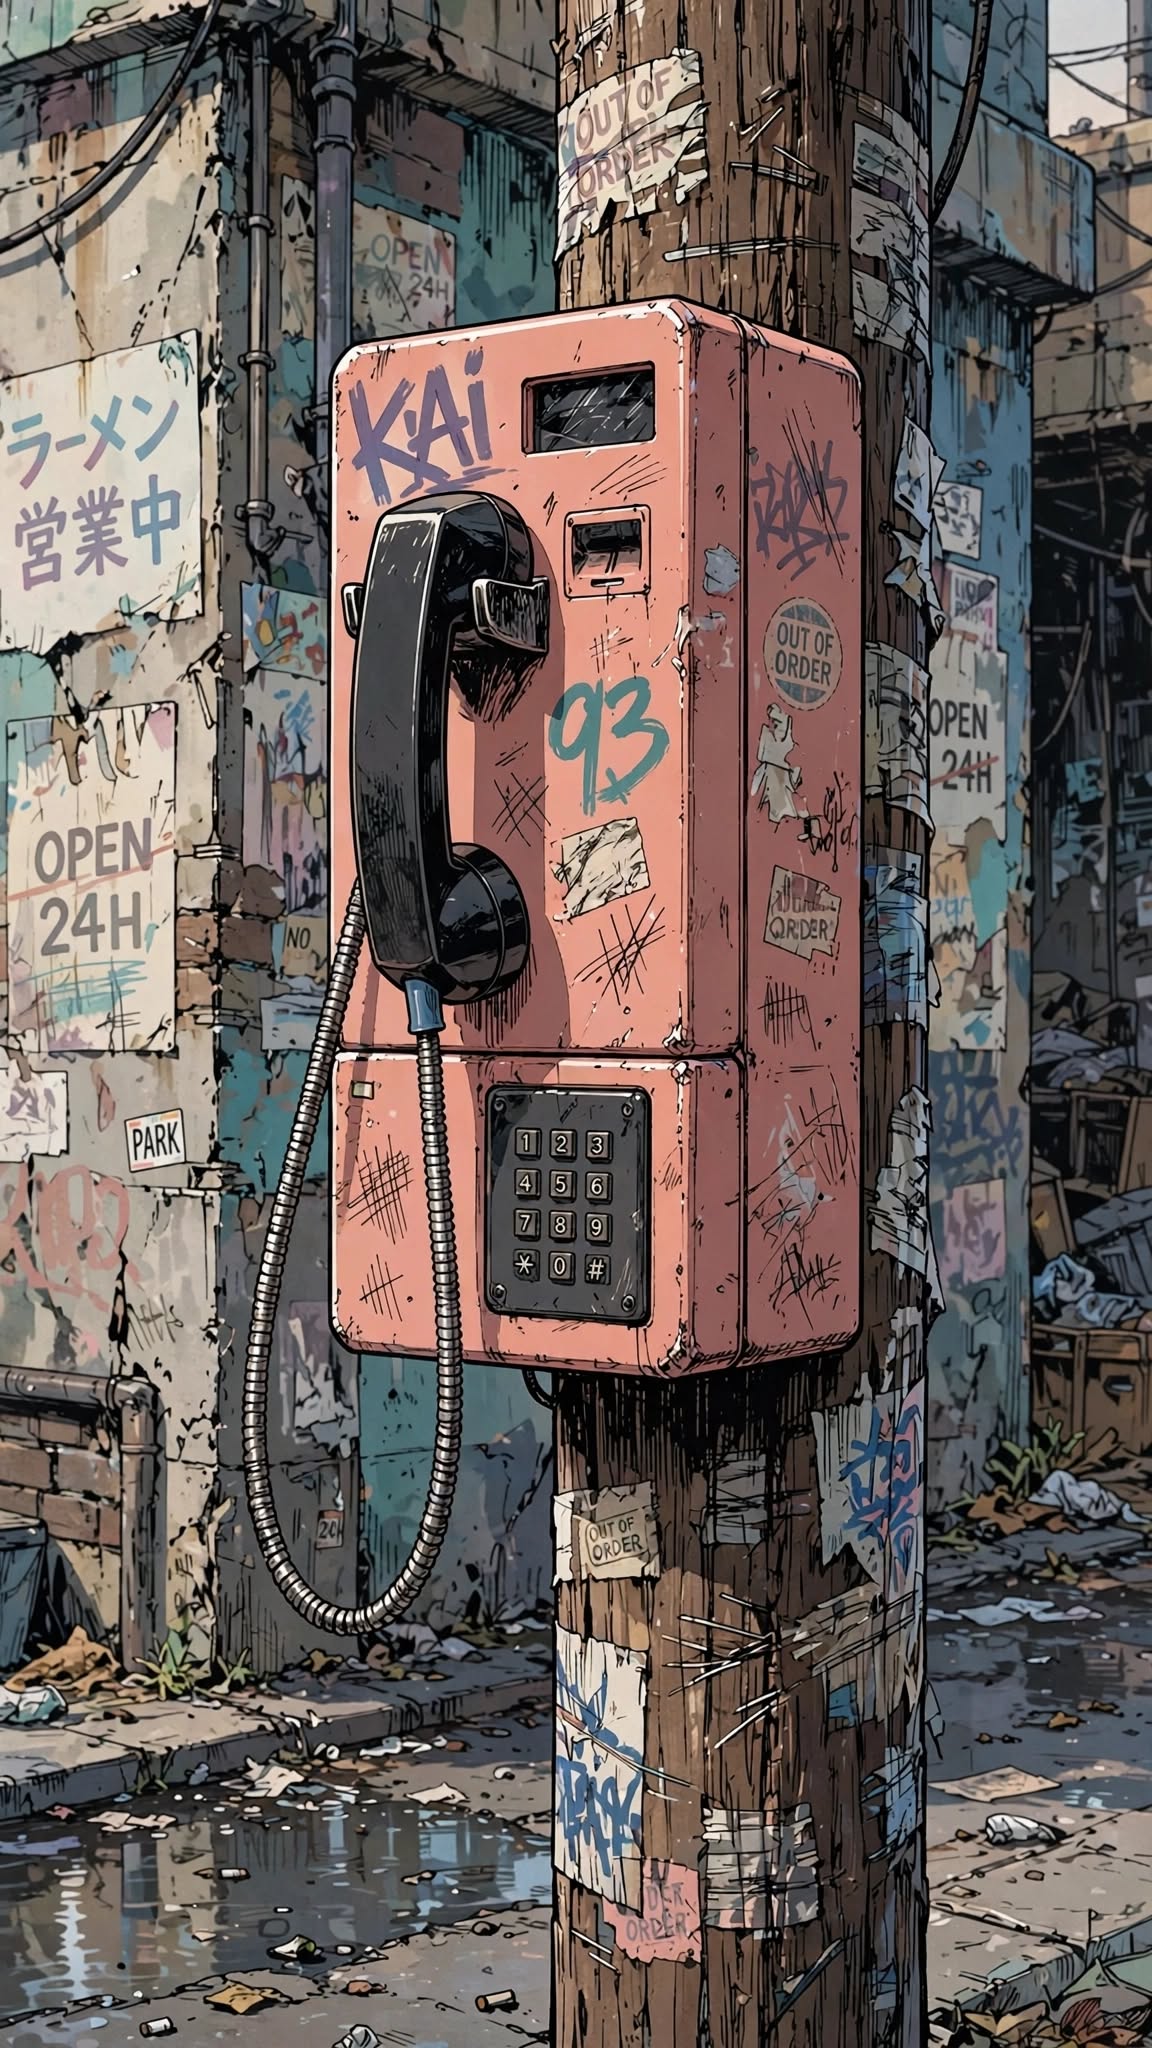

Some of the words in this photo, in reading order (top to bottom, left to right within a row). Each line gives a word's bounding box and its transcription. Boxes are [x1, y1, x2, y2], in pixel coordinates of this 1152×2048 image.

[576, 83, 631, 148] OUT
[636, 66, 673, 110] OF
[576, 138, 675, 197] ORDER
[371, 234, 441, 275] OPEN
[406, 272, 449, 300] 24H
[7, 395, 179, 490] ラーメン
[15, 474, 181, 591] 営業中
[777, 621, 810, 652] OUT
[815, 631, 834, 656] OF
[775, 650, 831, 687] ORDER
[929, 698, 987, 740] OPEN
[548, 676, 670, 816] 93
[942, 749, 992, 793] 24H
[35, 817, 153, 884] OPEN
[40, 891, 141, 956] 24H
[286, 927, 311, 949] NO
[132, 1121, 180, 1160] PARK
[522, 1134, 528, 1151] 1
[555, 1135, 567, 1153] 2
[591, 1136, 603, 1154] 3
[519, 1175, 531, 1192] 4
[555, 1176, 566, 1193] 5
[591, 1178, 603, 1195] 6
[519, 1215, 531, 1231] 7
[555, 1216, 566, 1234] 8
[591, 1218, 602, 1236] 9
[554, 1257, 566, 1275] 0
[590, 1522, 614, 1543] OUT
[619, 1516, 634, 1534] OF
[593, 1534, 643, 1561] ORDER
